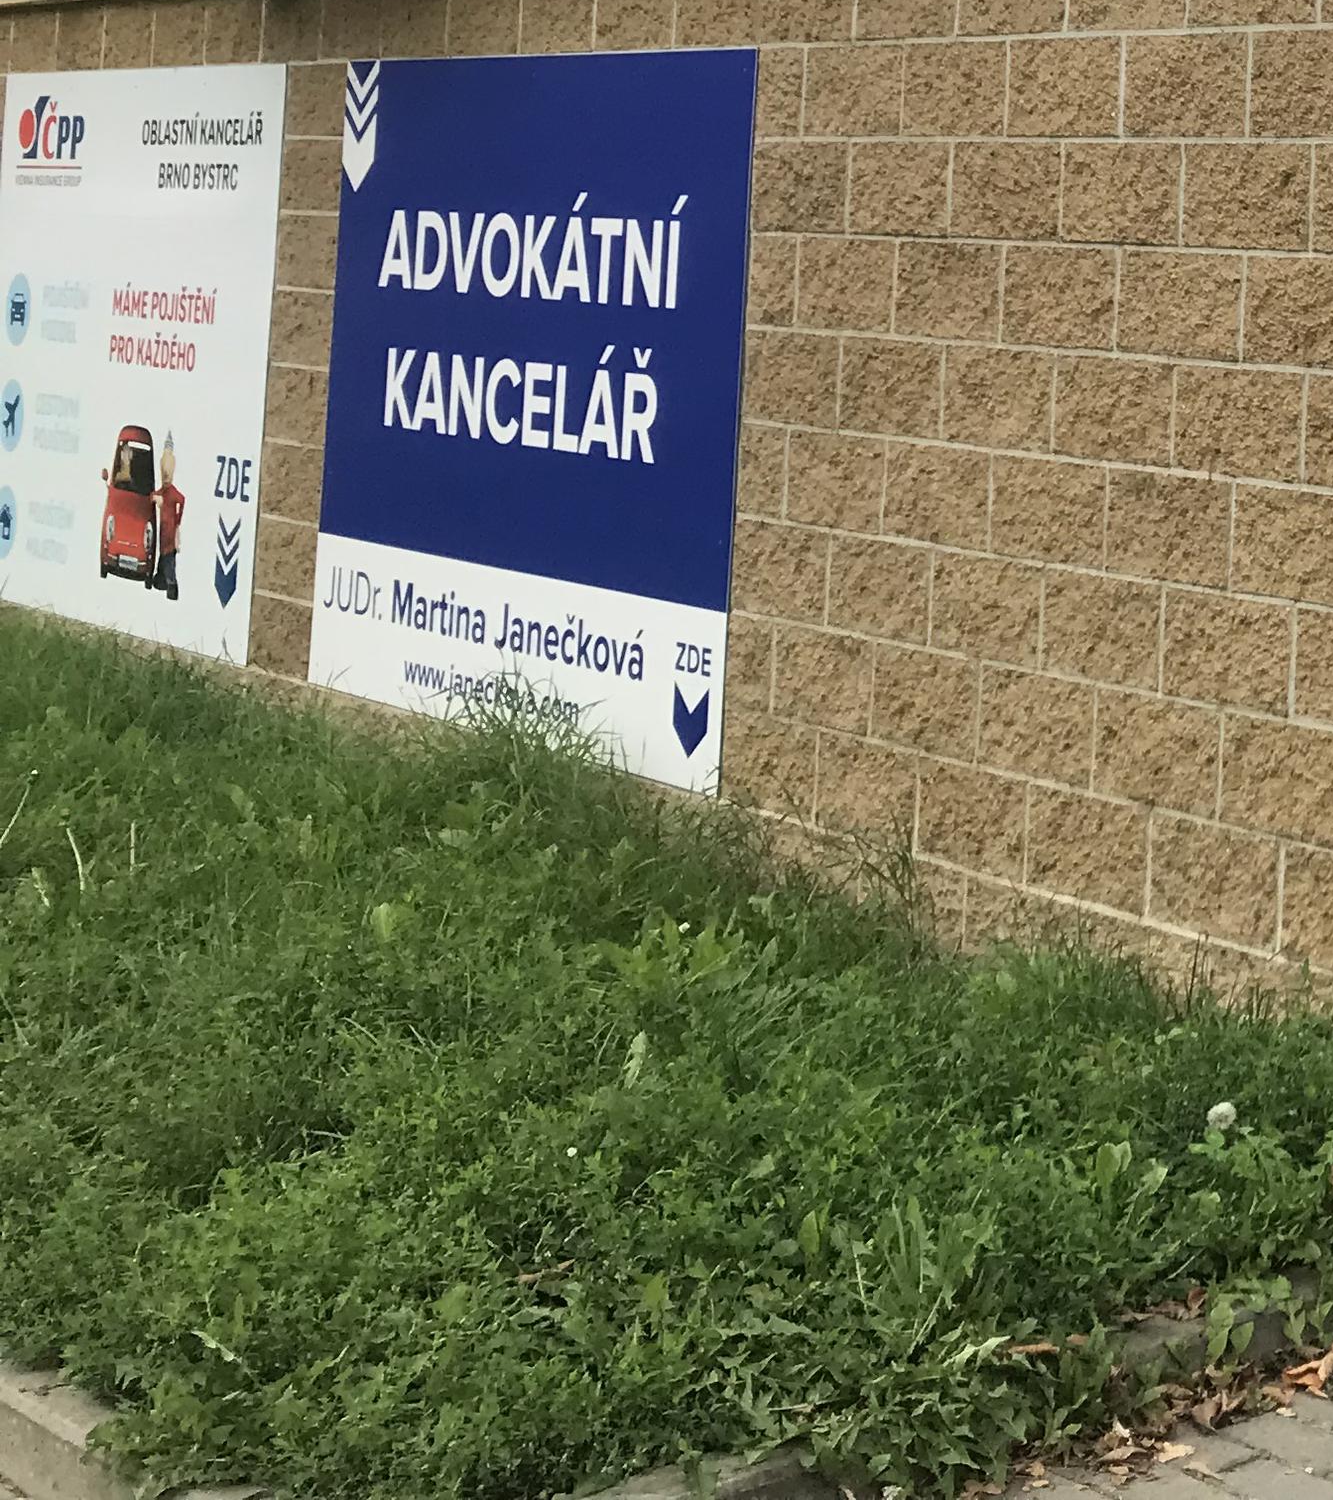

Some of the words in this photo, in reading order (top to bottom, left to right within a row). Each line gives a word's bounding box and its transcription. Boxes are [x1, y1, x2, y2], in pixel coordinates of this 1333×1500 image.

[42, 101, 85, 160] ČPP
[142, 111, 200, 146] OBLASTNÍ
[200, 110, 263, 146] KANCELÁŘ
[158, 162, 190, 189] BRNO
[193, 163, 239, 190] BYSTRC
[377, 192, 689, 310] ADVOKÁTNÍ
[111, 281, 149, 319] MÁME
[150, 285, 218, 325] POJIŠTĚNÍ
[109, 334, 134, 364] PRO
[136, 331, 196, 372] KAŽDÉHO
[383, 344, 658, 464] KANCELÁŘ
[214, 455, 252, 503] ZDE
[323, 566, 383, 621] JUDr.
[391, 578, 486, 645] Martina
[494, 603, 646, 682] Janečková
[675, 641, 713, 678] ZDE
